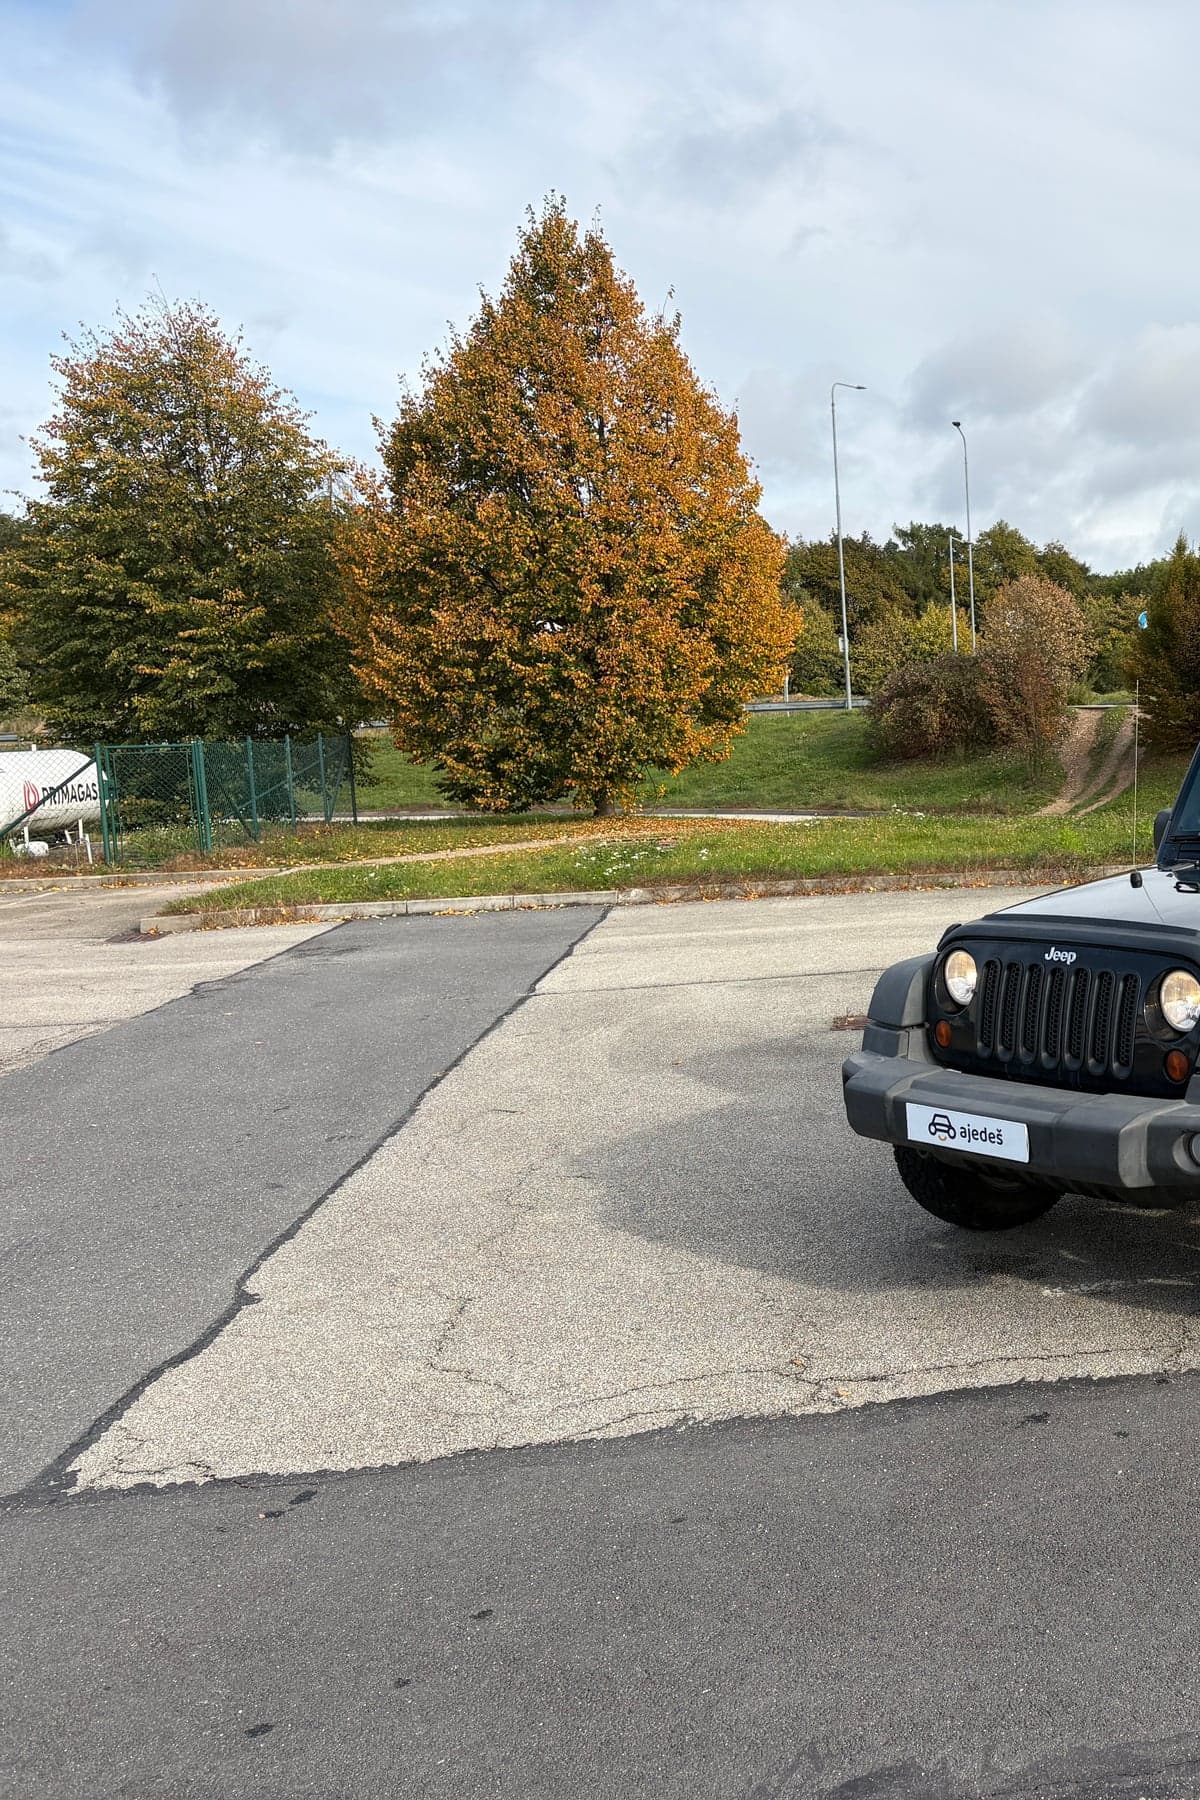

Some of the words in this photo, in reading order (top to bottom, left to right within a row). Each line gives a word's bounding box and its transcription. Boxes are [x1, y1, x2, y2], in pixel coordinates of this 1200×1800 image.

[41, 782, 98, 806] PRIMAGAS
[1044, 946, 1077, 965] Jeep
[959, 1123, 1004, 1145] ajedeš
